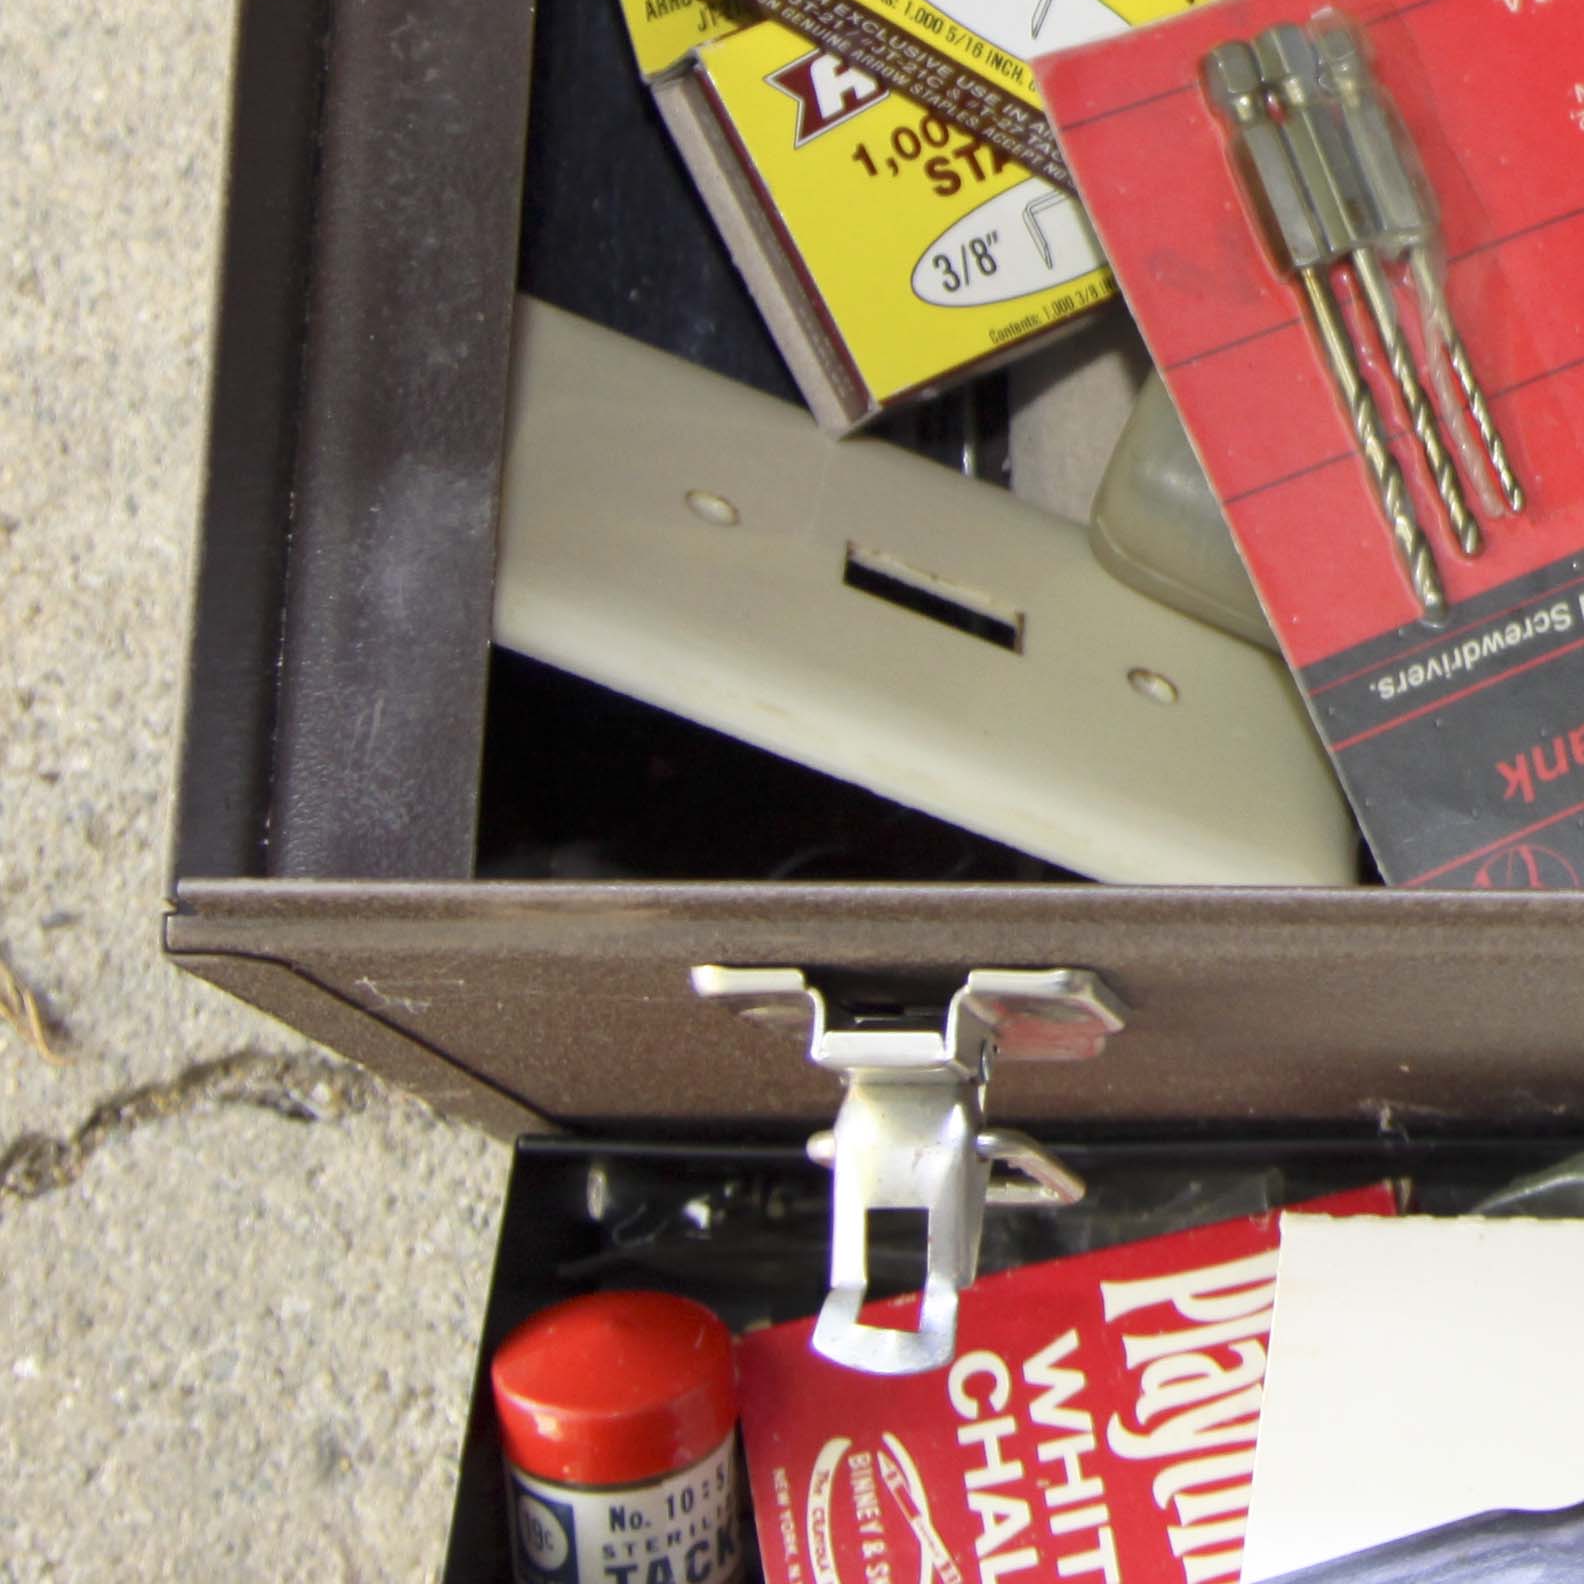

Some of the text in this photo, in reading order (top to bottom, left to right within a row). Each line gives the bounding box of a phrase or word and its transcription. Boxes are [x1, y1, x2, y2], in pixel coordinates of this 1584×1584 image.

[781, 7, 851, 53] GENUINE
[851, 48, 911, 86] ARROW
[833, 2, 954, 79] EXCLUSIVE
[955, 74, 1001, 108] USE
[1002, 102, 1029, 123] IN
[945, 27, 983, 59] 5/16
[853, 115, 949, 178] 1,00
[932, 230, 999, 293] 3/8"
[1368, 599, 1573, 703] Screwdrivers.
[773, 1467, 791, 1507] NEW
[947, 1348, 1040, 1584] CHAL
[1022, 1327, 1121, 1584] WHIT
[609, 1504, 653, 1533] No.
[848, 1451, 885, 1534] BINNEY
[604, 1524, 734, 1584] TACK
[860, 1538, 887, 1560] &
